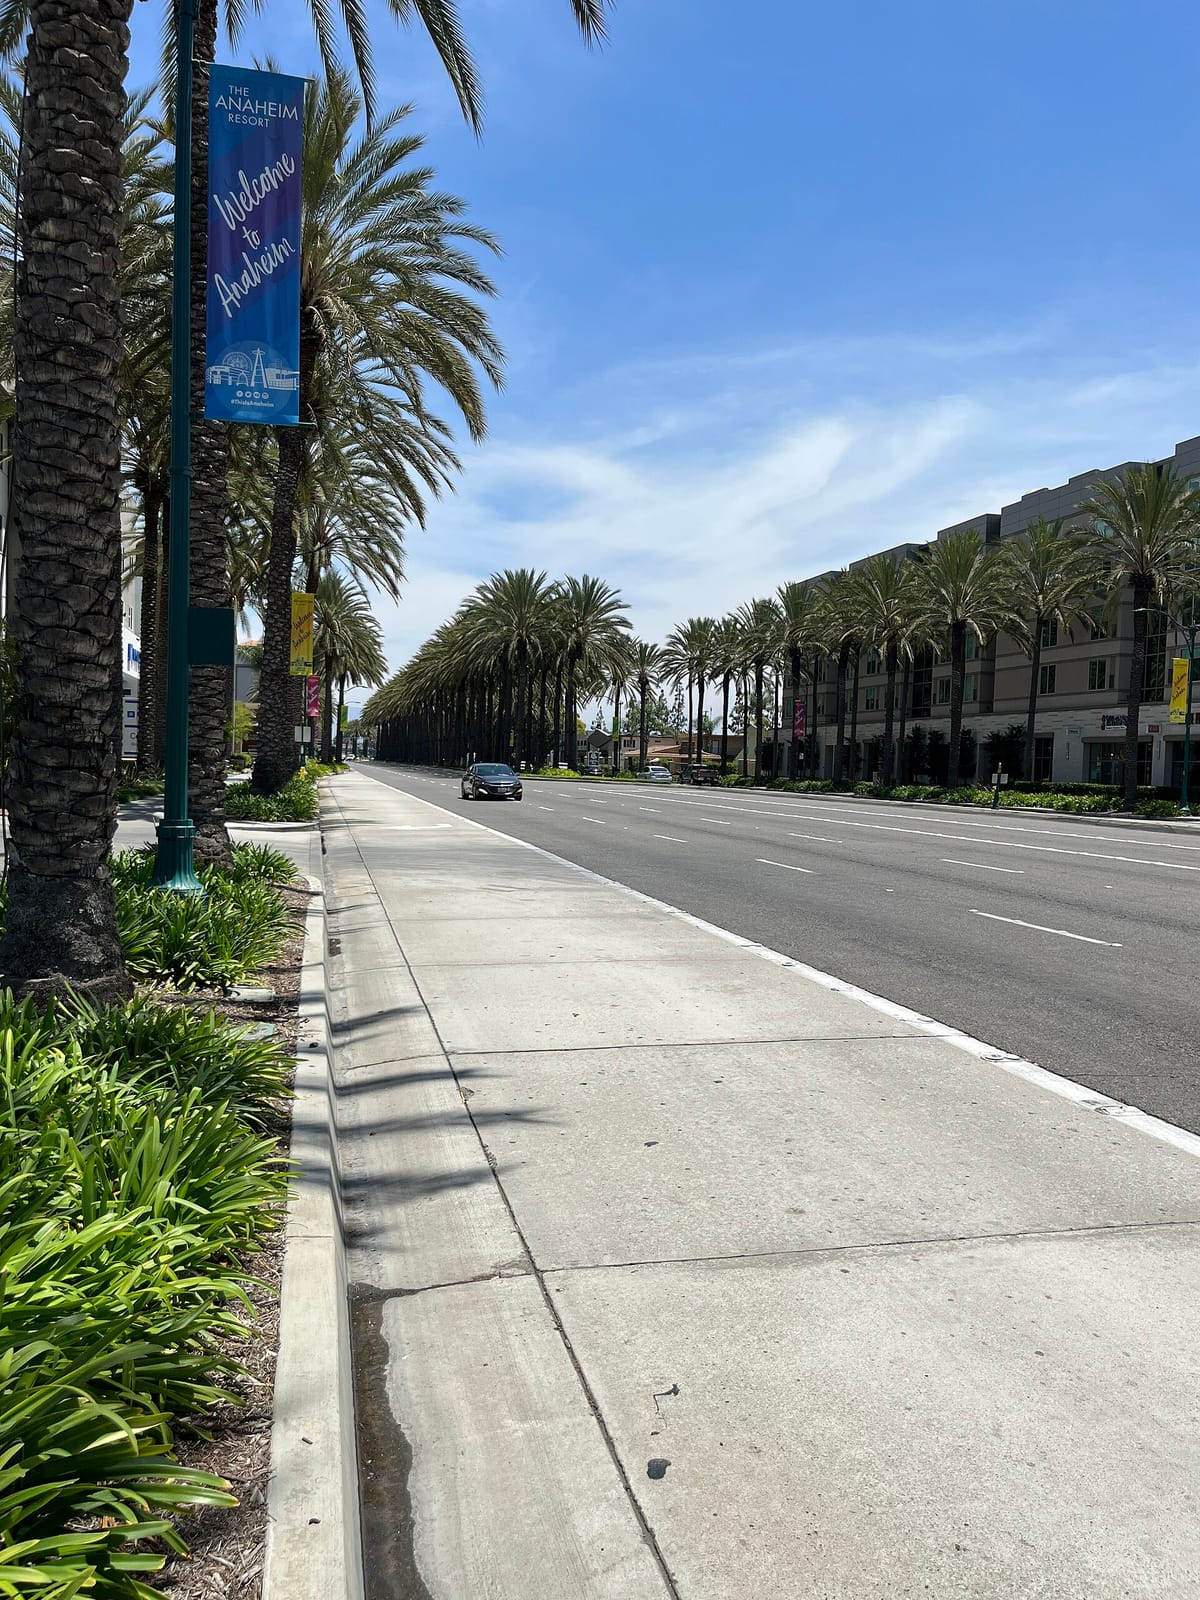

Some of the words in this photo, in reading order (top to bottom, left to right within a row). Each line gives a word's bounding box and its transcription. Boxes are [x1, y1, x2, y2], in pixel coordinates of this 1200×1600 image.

[228, 84, 250, 97] THE
[215, 95, 299, 121] ANAHEIM
[228, 113, 270, 128] RESORT
[213, 152, 296, 231] Welcome
[242, 225, 261, 250] to
[214, 236, 296, 318] Anaheim
